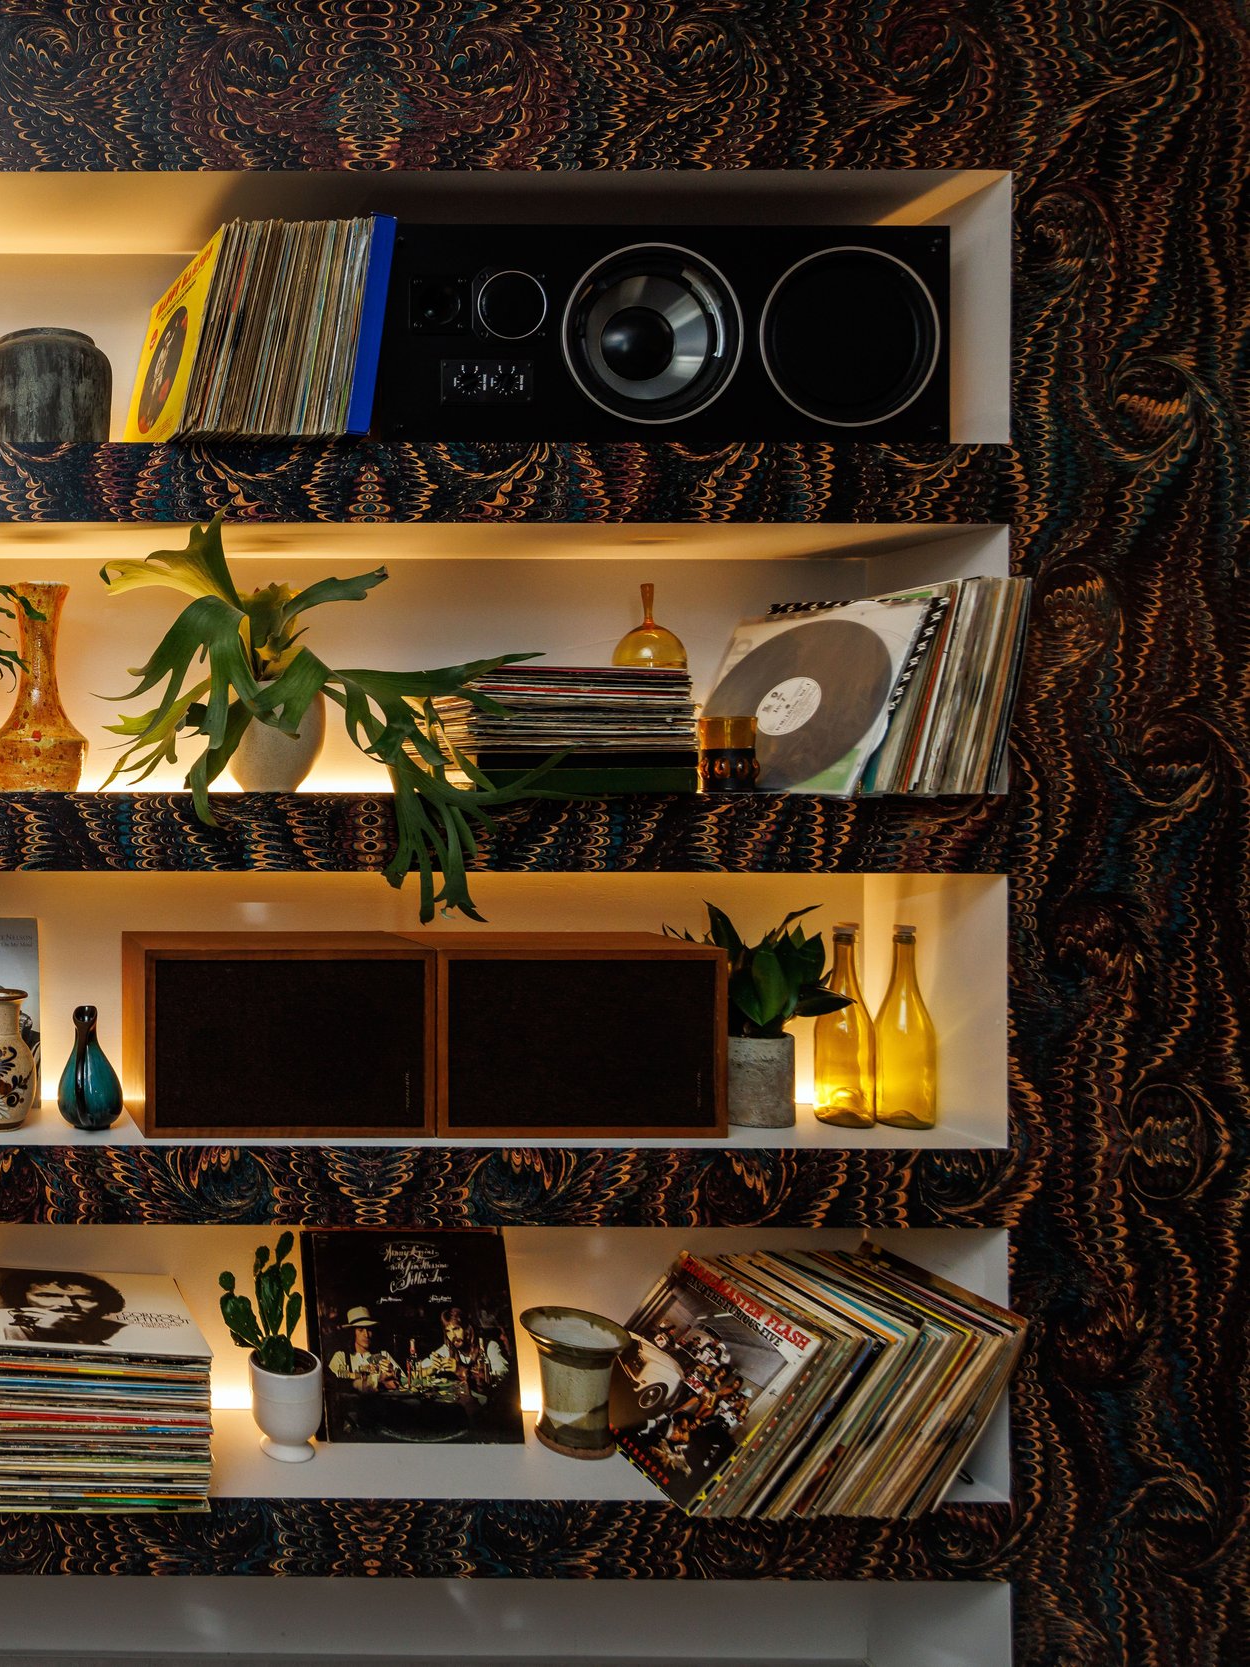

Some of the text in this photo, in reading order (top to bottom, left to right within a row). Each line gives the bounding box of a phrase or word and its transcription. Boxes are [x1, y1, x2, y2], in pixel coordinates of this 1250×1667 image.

[5, 933, 33, 941] NELSON
[681, 1257, 812, 1352] GRANDMASTER FLASH
[686, 1277, 784, 1347] AND THE FURIOUS FIVE
